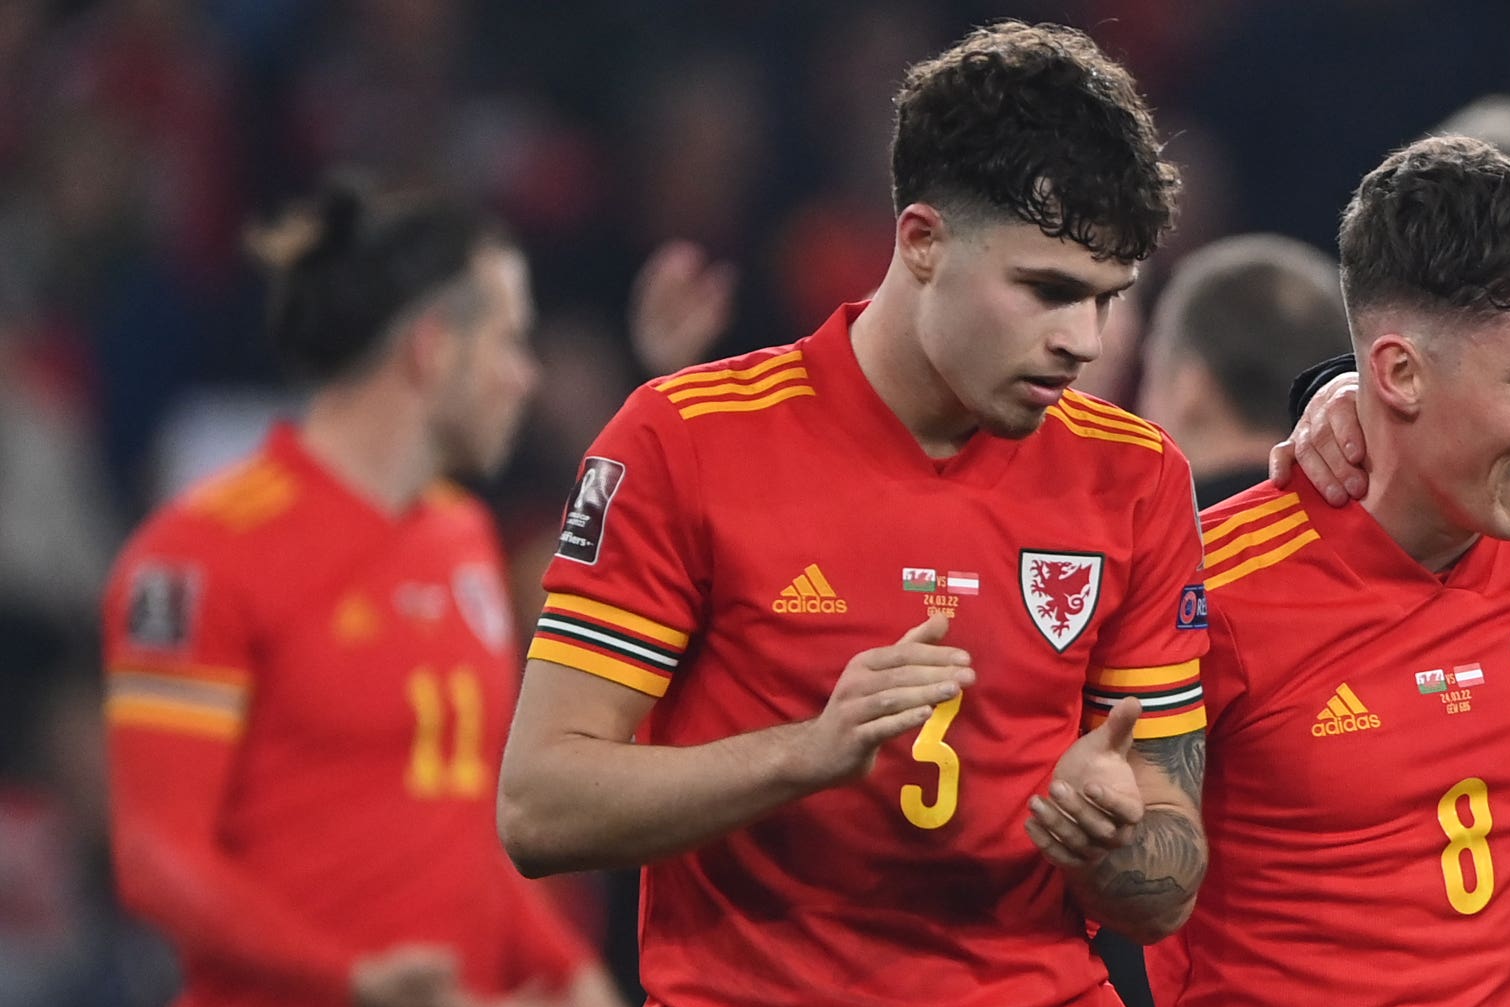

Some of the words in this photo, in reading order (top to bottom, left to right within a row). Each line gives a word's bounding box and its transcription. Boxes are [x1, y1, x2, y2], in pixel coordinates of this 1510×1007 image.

[772, 595, 847, 613] adidas
[405, 668, 487, 796] 11
[901, 690, 963, 829] 3
[1311, 713, 1381, 737] adidas
[1437, 777, 1495, 915] 8
